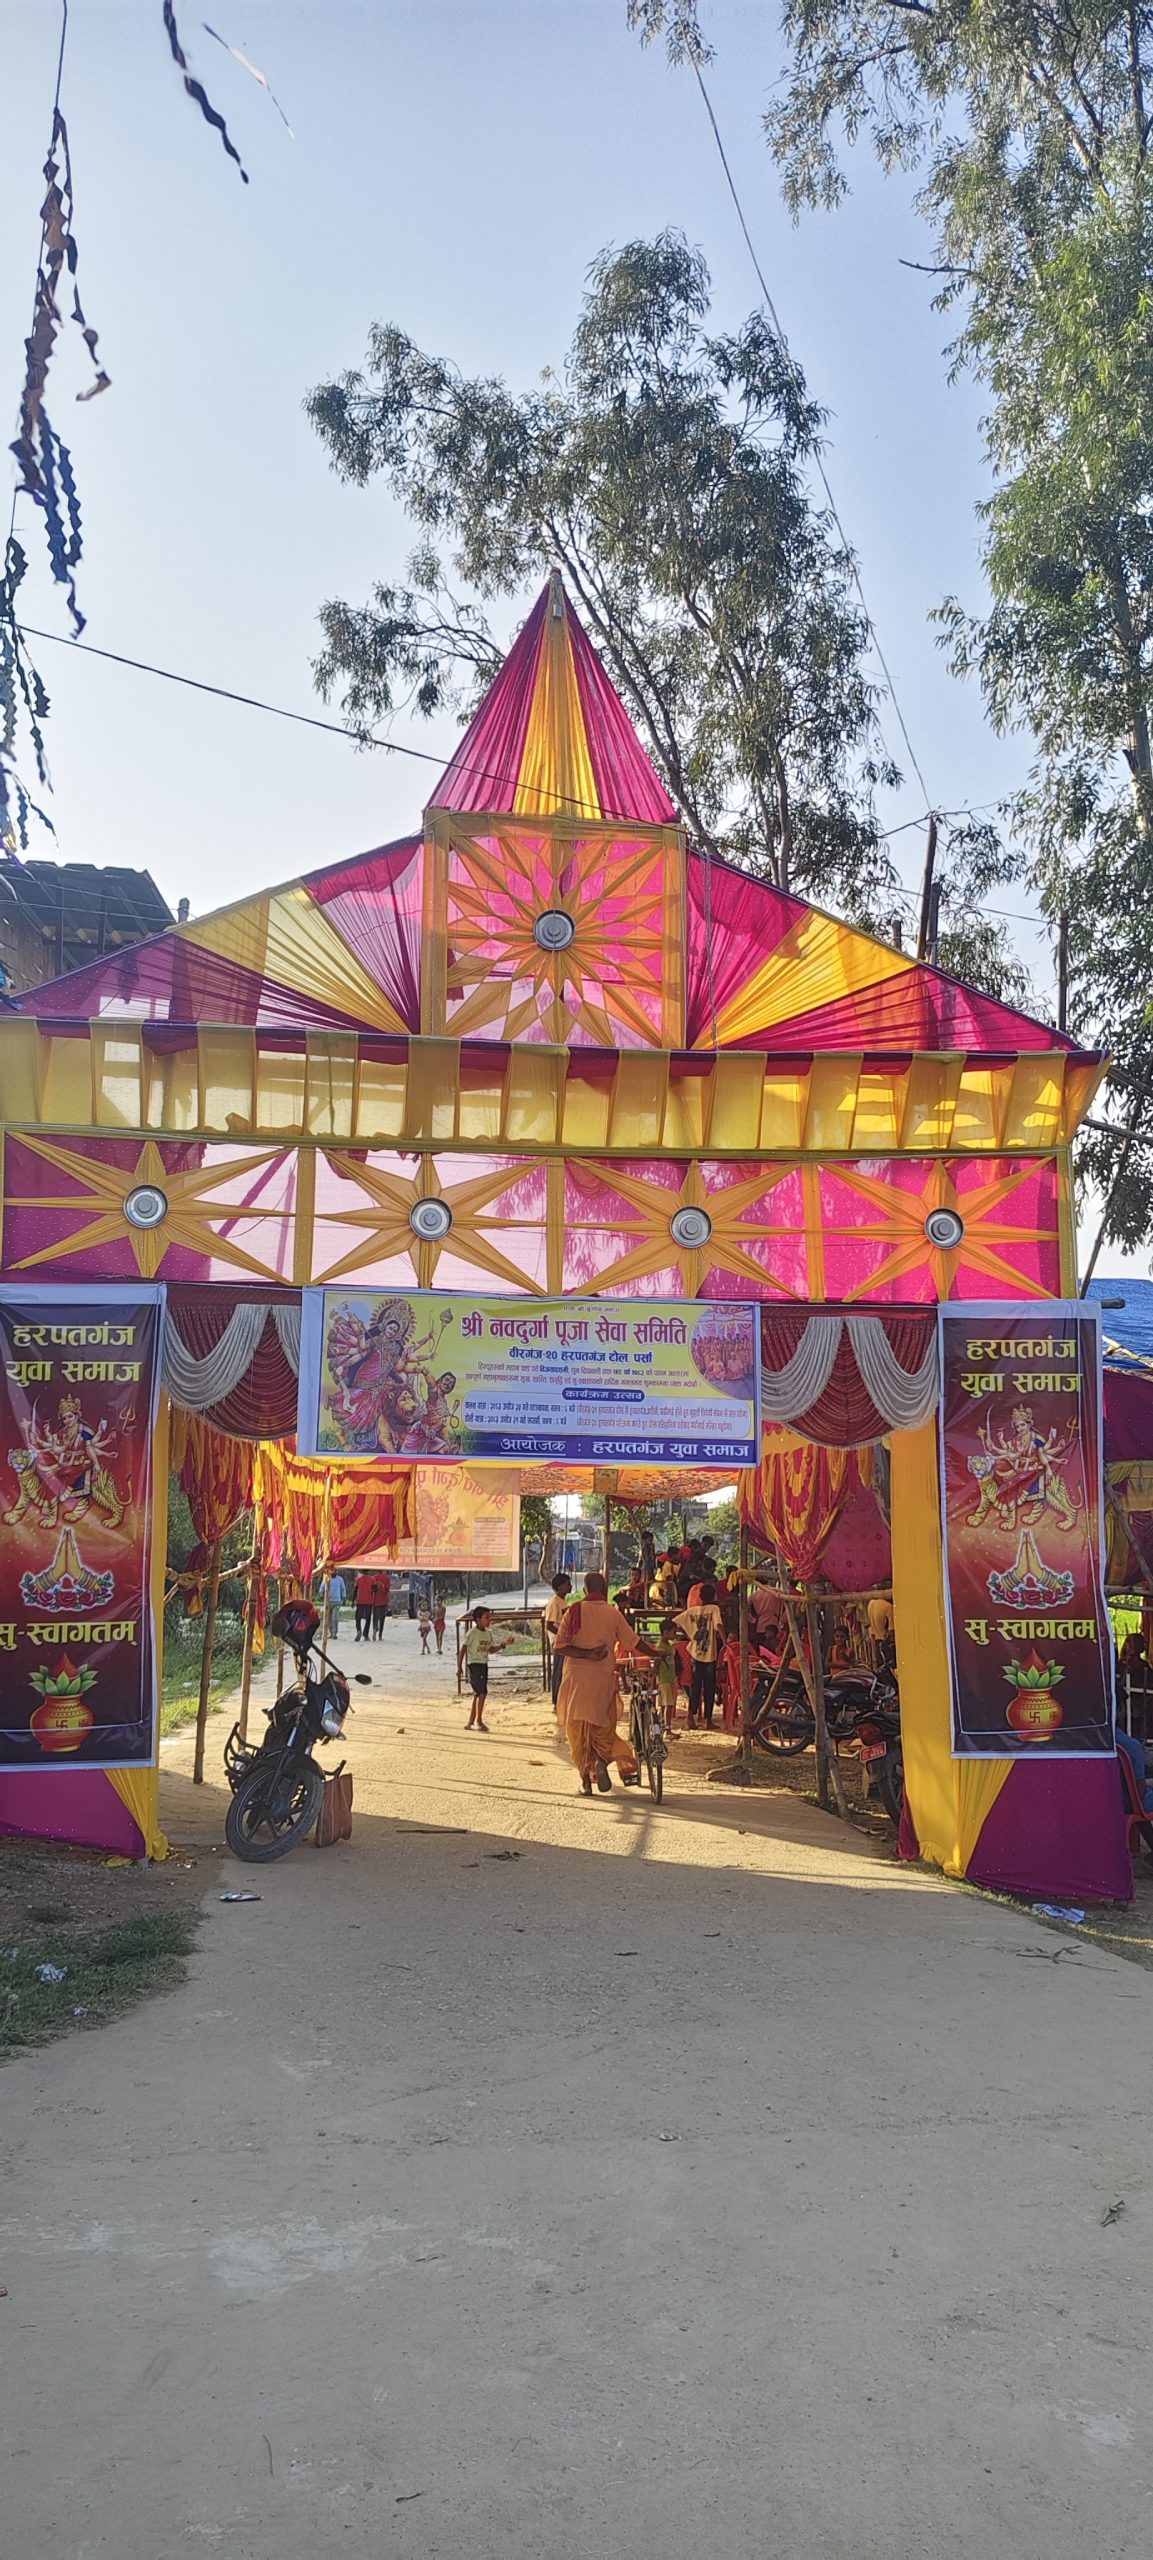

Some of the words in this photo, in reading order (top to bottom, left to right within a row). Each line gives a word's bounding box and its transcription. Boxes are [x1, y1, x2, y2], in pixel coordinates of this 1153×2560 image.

[13, 1321, 136, 1347] हरपतगंज
[462, 1311, 483, 1337] श्री
[489, 1315, 549, 1344] नवदुर्गा
[555, 1320, 589, 1346] पूजा
[595, 1315, 627, 1343] सेवा
[633, 1316, 688, 1344] समिति
[561, 1350, 606, 1362] हरपतगंज
[634, 1351, 653, 1363] पर्सा
[966, 1335, 1076, 1360] हरपतगंज
[6, 1361, 54, 1388] युवा
[61, 1361, 142, 1383] समाज
[961, 1373, 1005, 1398] युवा
[1012, 1373, 1083, 1394] समाज
[565, 1389, 609, 1399] कार्यक्रम
[613, 1391, 642, 1400] उत्सव
[500, 1436, 566, 1451] आयोजक
[592, 1440, 665, 1454] हरपतगंज
[670, 1444, 698, 1457] युवा
[703, 1444, 750, 1457] समाज
[964, 1619, 1098, 1645] सु-स्वागतम्
